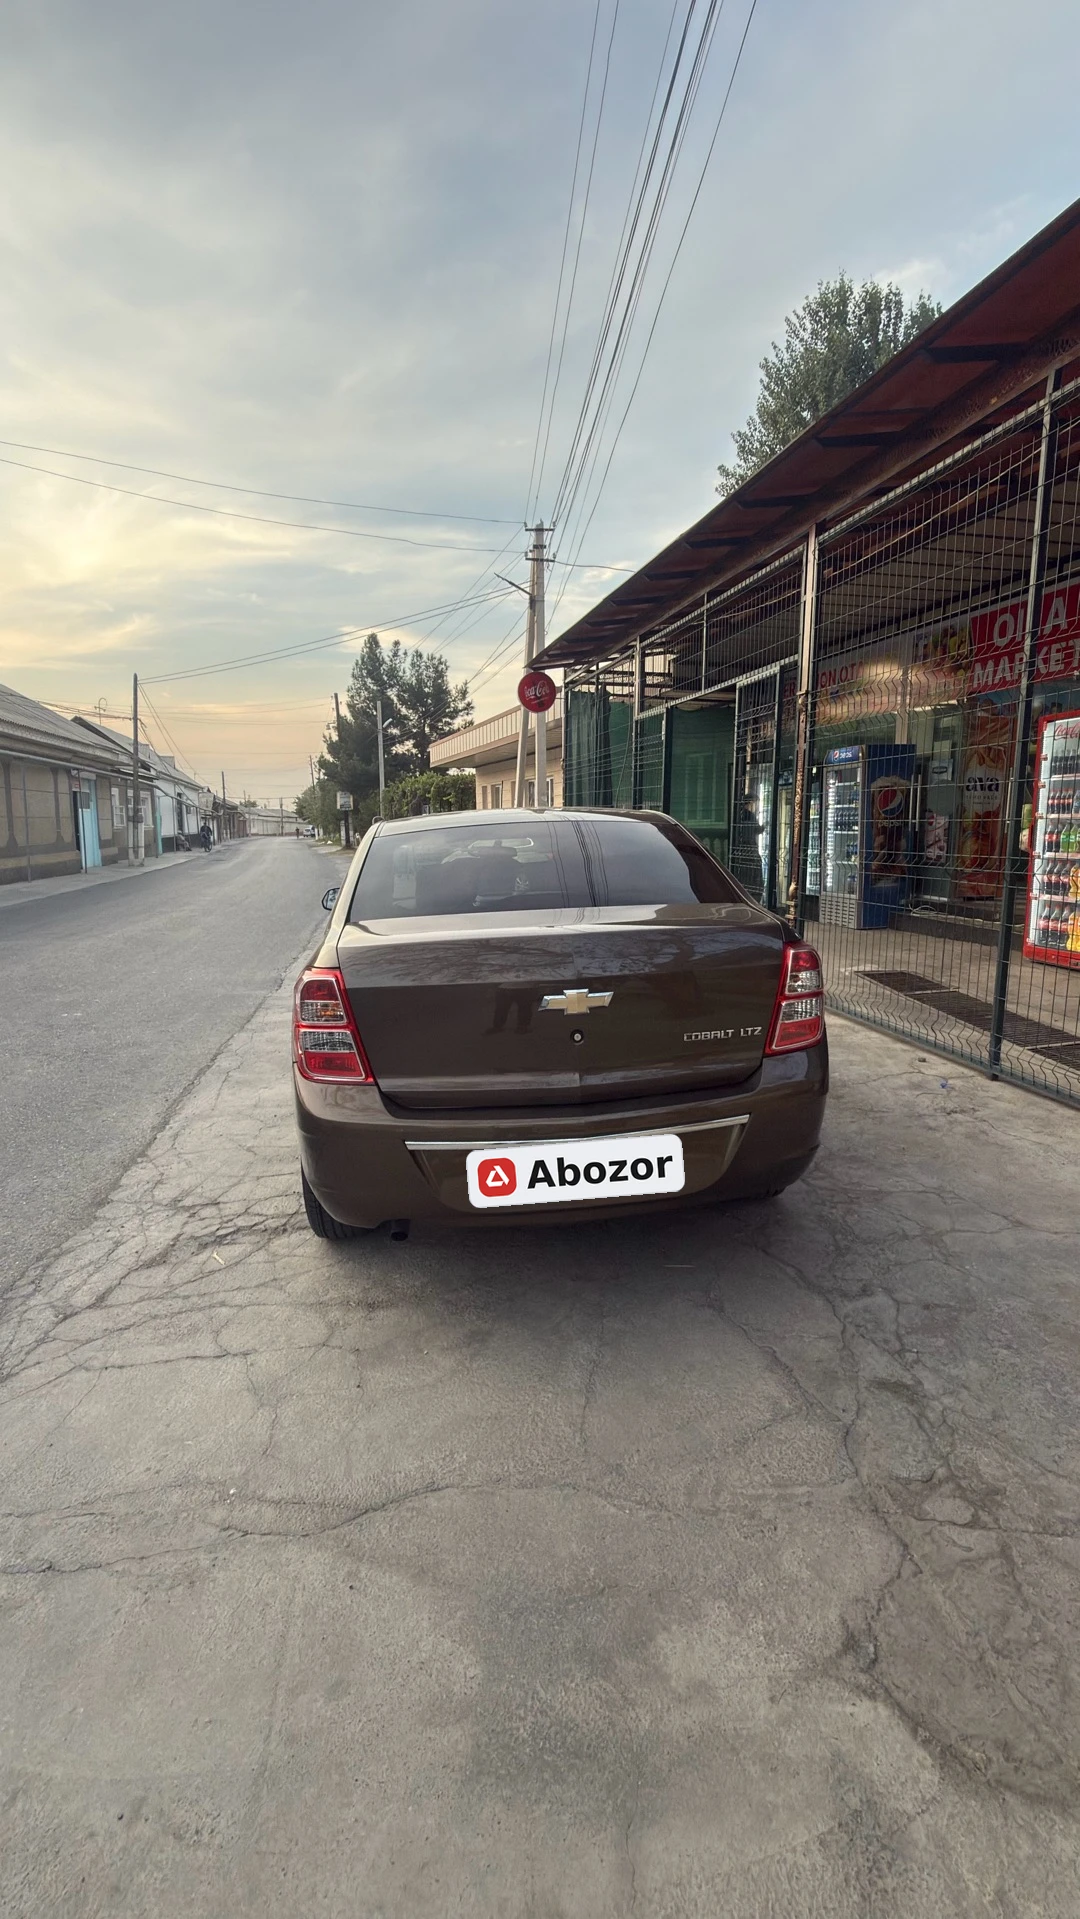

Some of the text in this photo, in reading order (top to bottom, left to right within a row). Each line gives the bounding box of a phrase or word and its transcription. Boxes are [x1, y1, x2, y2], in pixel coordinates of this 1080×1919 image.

[993, 596, 1068, 646] OIA
[966, 776, 1000, 792] ava
[683, 1026, 762, 1042] COBALT LTZ
